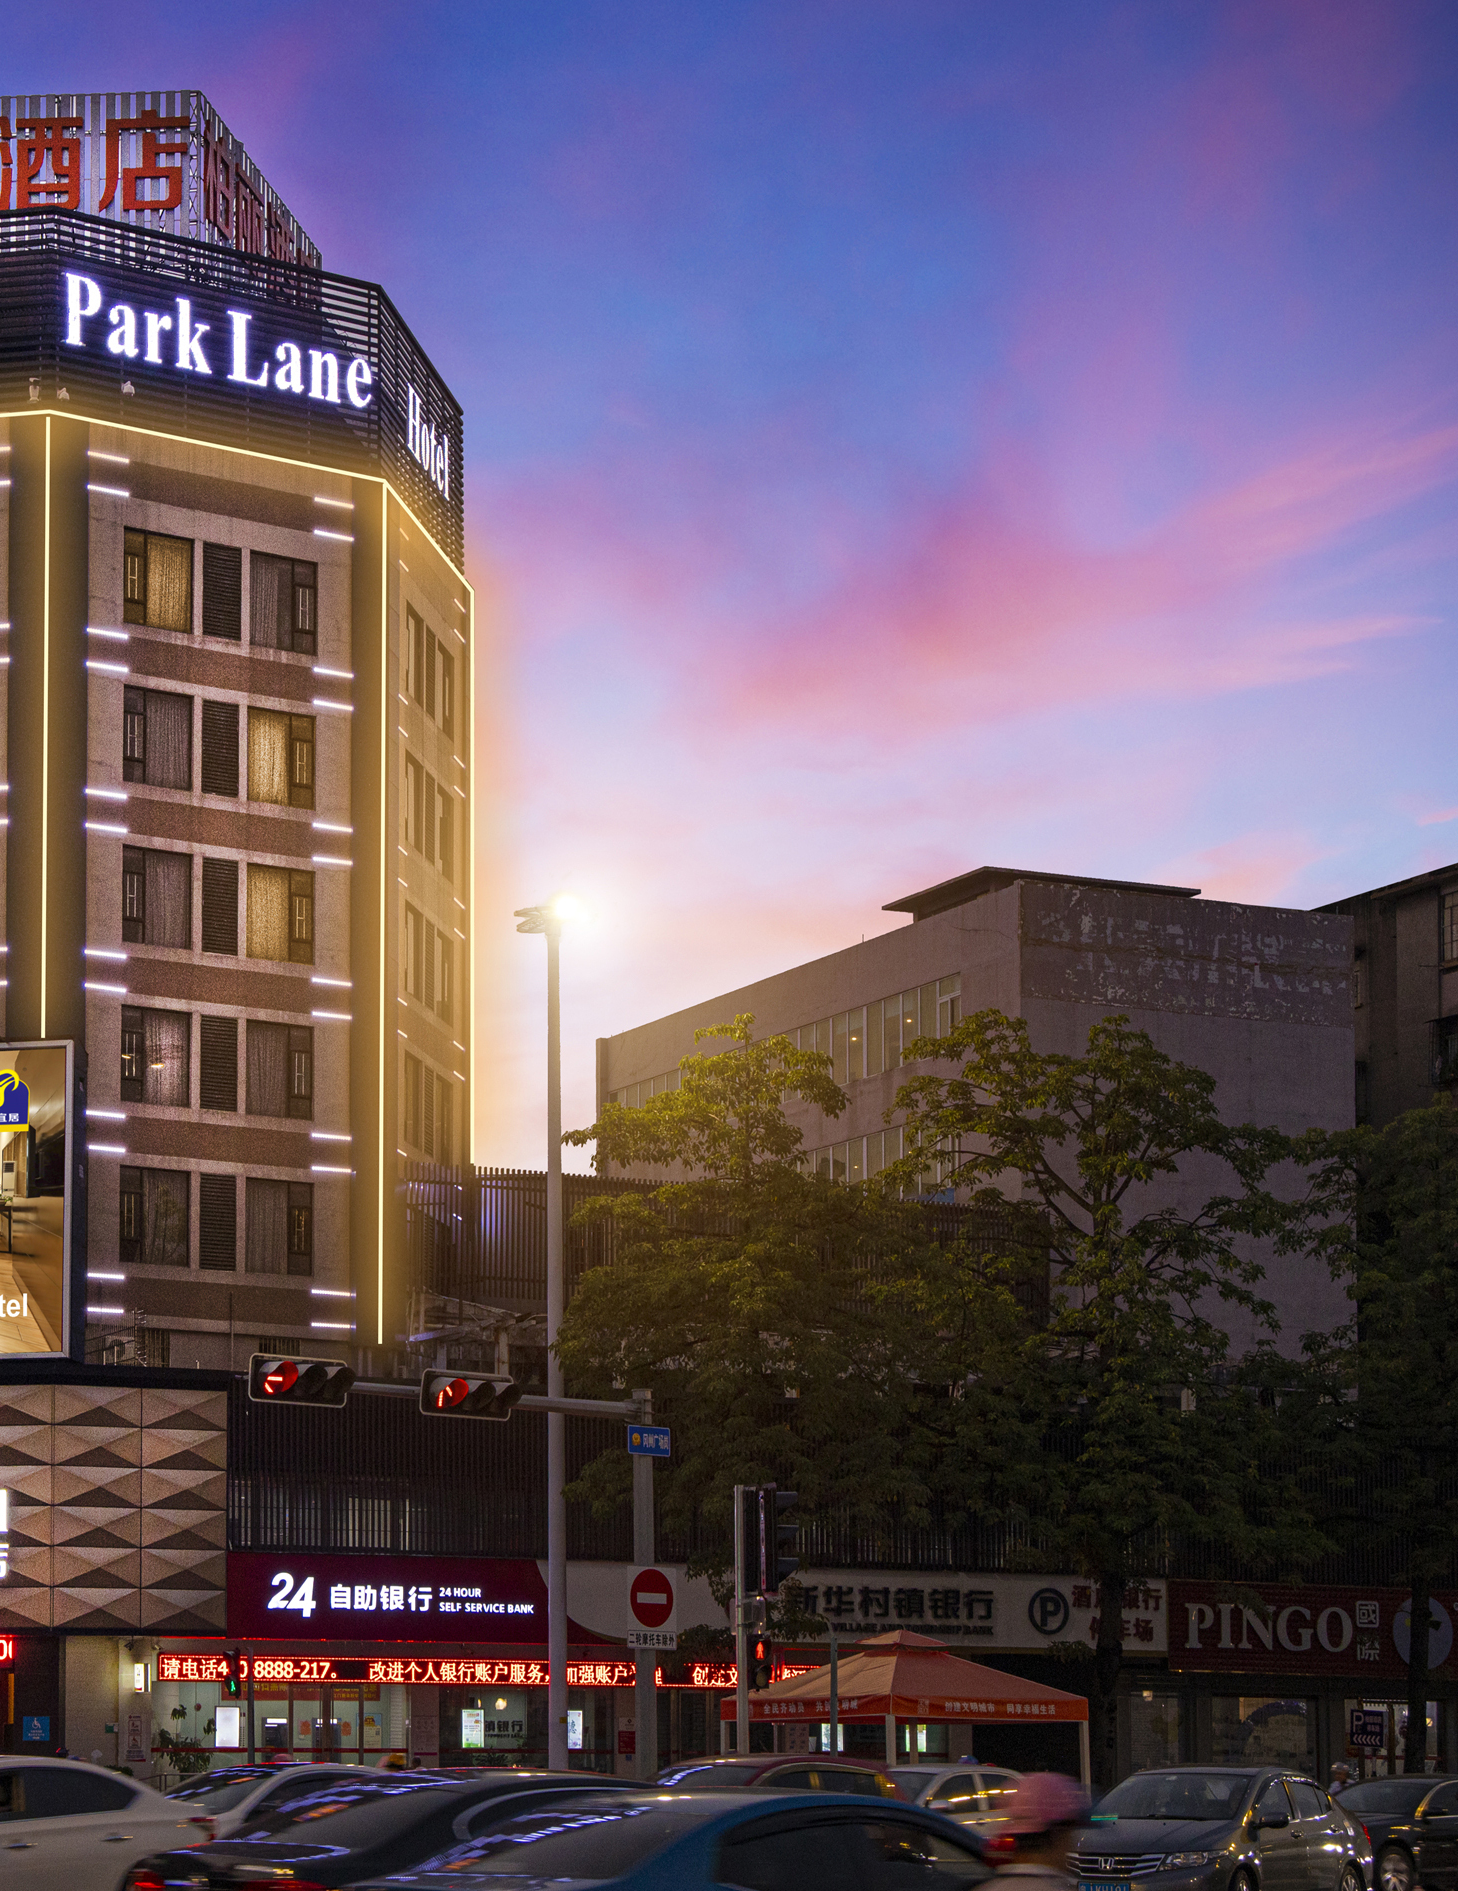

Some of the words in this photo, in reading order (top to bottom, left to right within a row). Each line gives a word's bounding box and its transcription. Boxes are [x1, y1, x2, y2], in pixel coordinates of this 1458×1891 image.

[63, 270, 213, 376] Park
[228, 310, 374, 408] Lane
[405, 383, 451, 502] Hotel
[267, 1571, 317, 1618] 24
[329, 1583, 433, 1613] 自助银行
[439, 1587, 451, 1598] 24
[453, 1587, 482, 1599] HOUR
[797, 1585, 994, 1620] 新华村镇银行
[439, 1601, 462, 1613] SELF
[465, 1602, 506, 1614] SERVICE
[508, 1603, 534, 1615] BANK
[963, 1625, 994, 1636] BANK
[1184, 1602, 1354, 1653] PINGO
[629, 1633, 675, 1646] 二轮摩托车除外
[945, 1701, 995, 1713] 创建文明城市
[1007, 1703, 1056, 1715] 同享幸福生活
